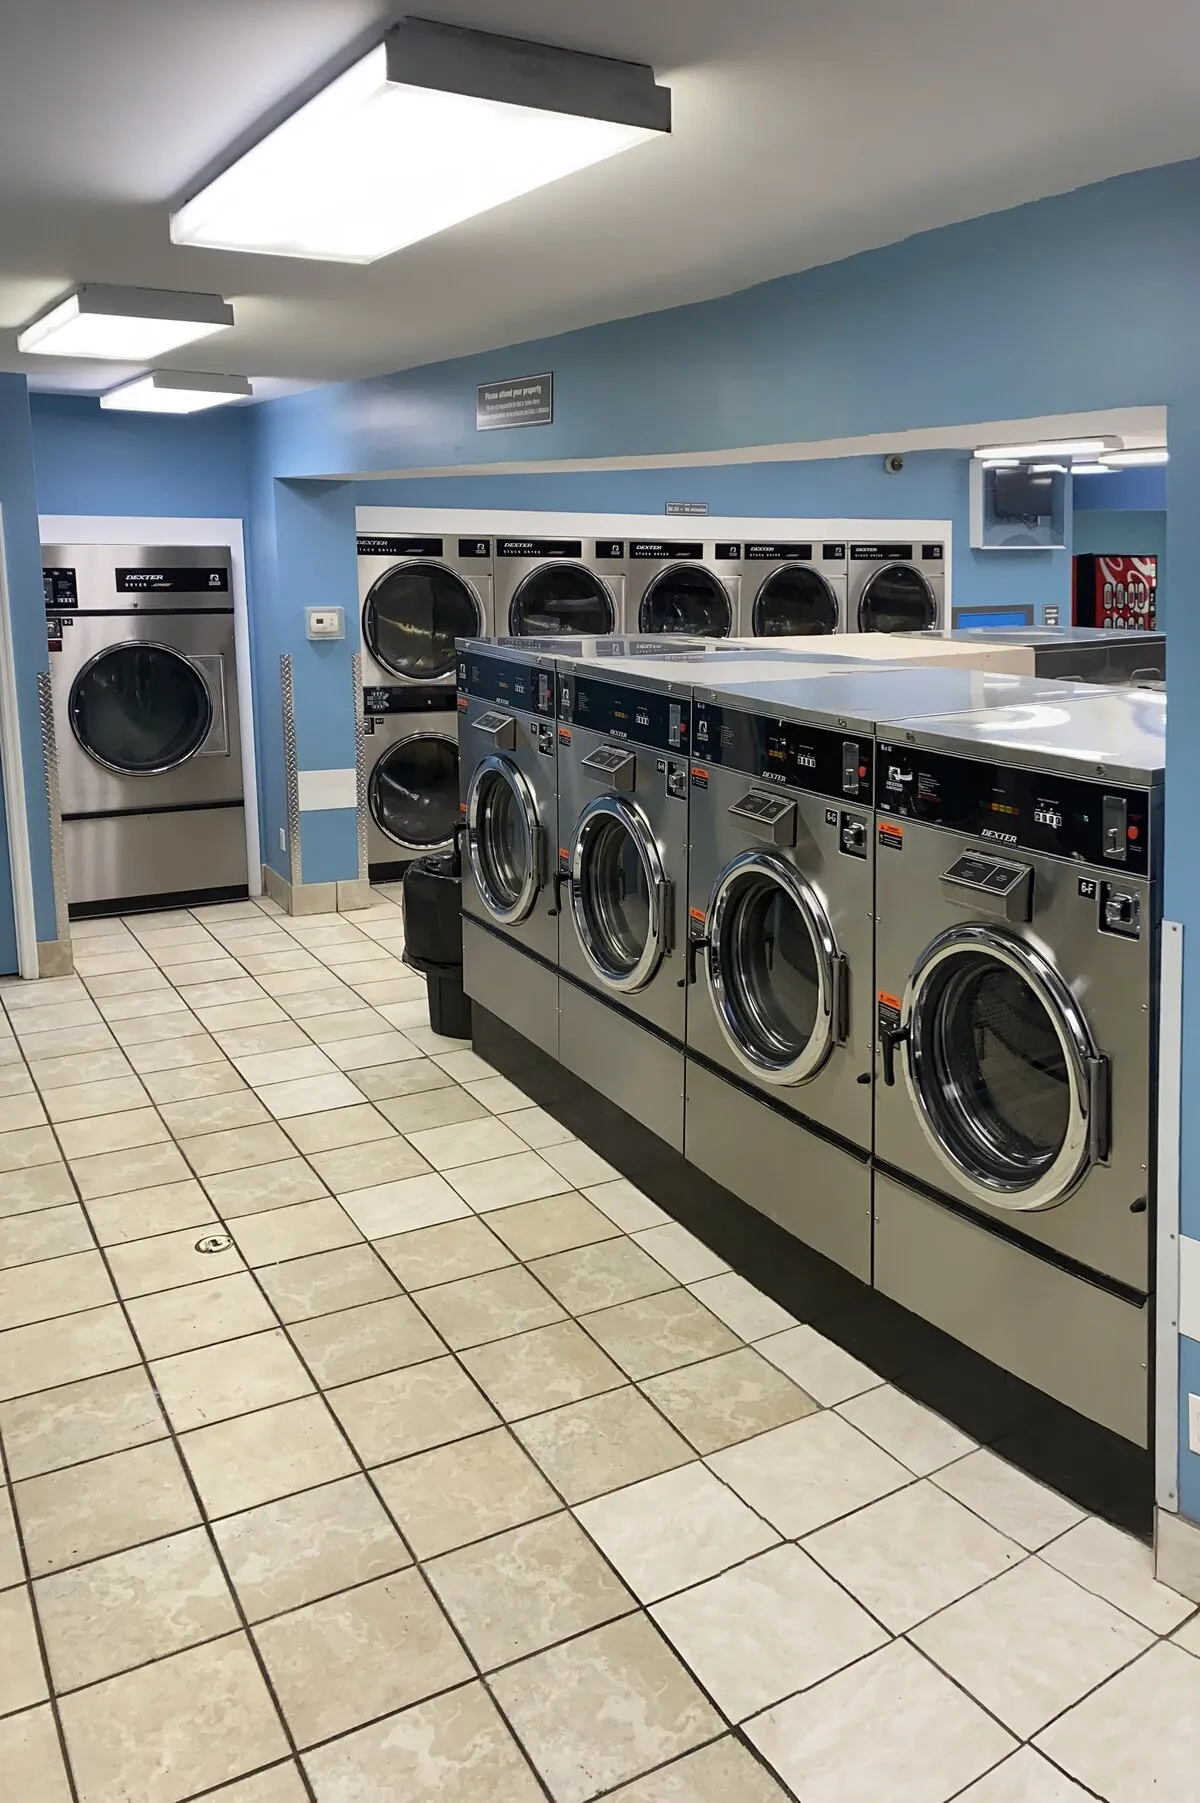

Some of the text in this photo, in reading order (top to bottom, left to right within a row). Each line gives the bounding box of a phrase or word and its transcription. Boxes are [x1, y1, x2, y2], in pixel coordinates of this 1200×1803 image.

[485, 385, 541, 400] Please attend your property
[762, 771, 786, 782] DEXTER
[826, 811, 836, 823] 6-G
[981, 829, 1017, 843] DEXTER
[1081, 882, 1093, 894] 6-F
